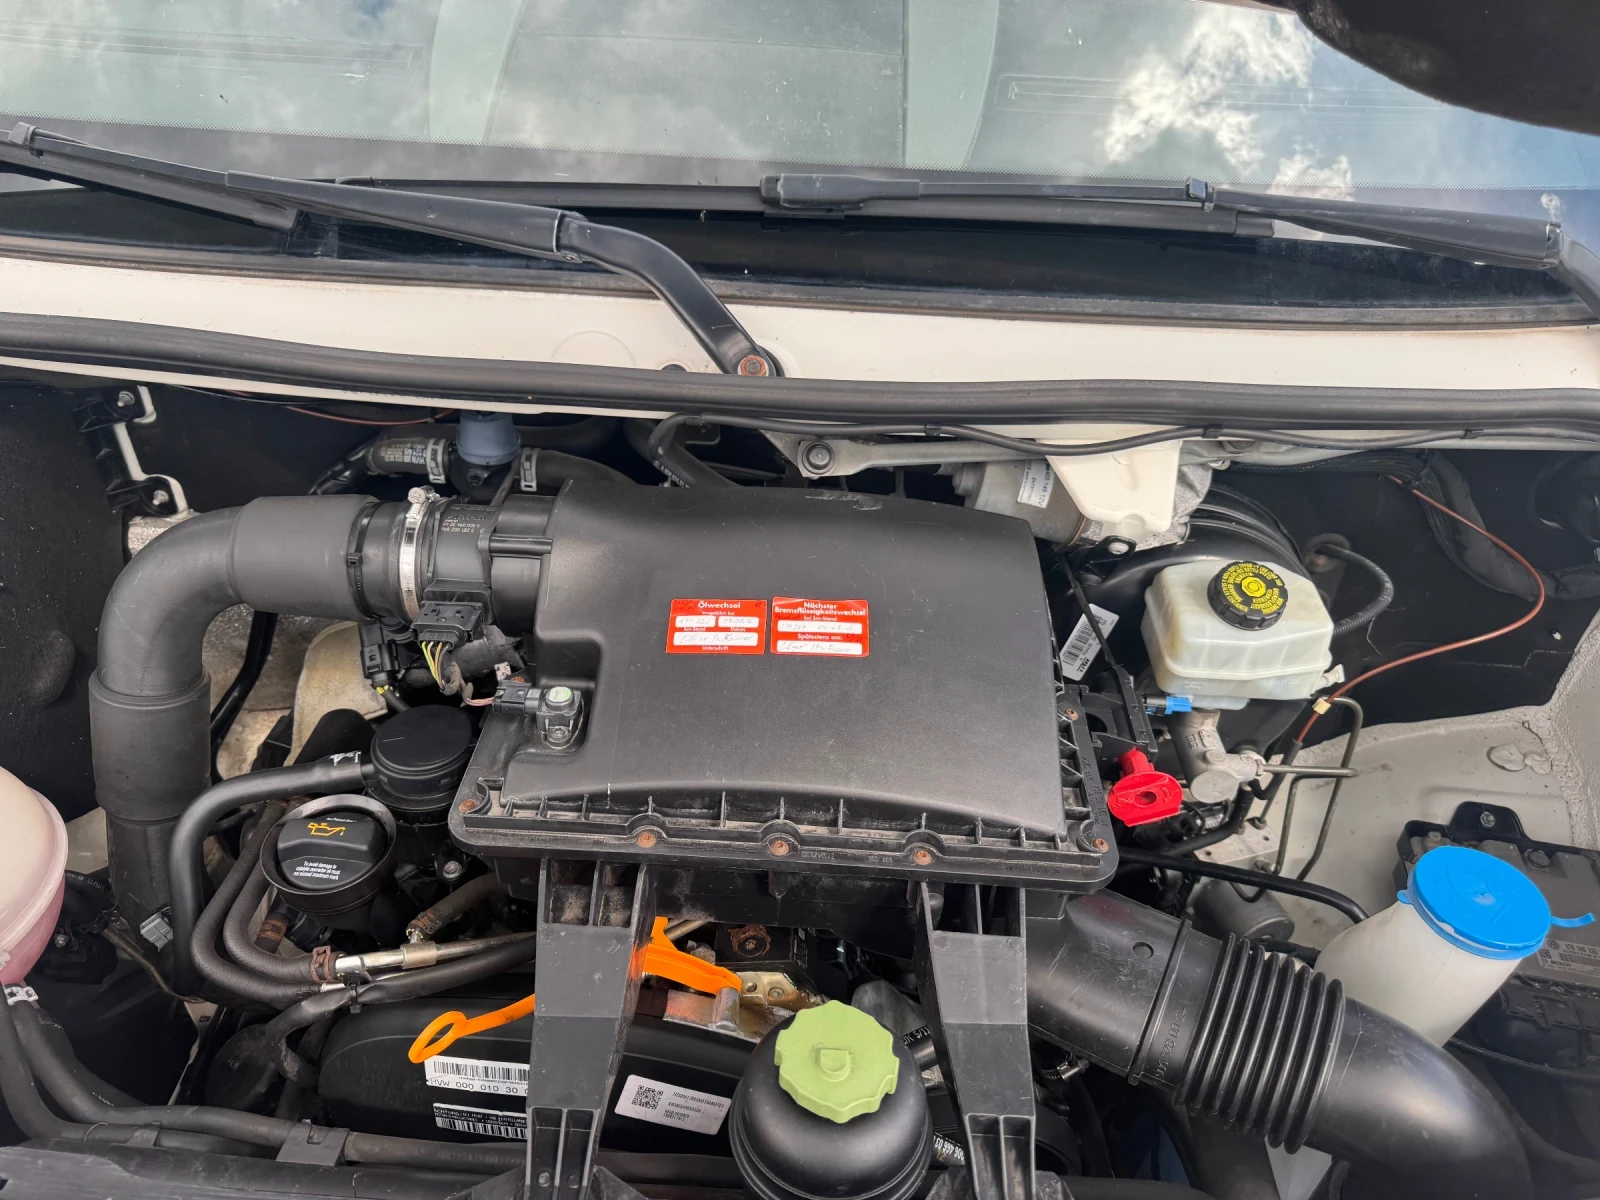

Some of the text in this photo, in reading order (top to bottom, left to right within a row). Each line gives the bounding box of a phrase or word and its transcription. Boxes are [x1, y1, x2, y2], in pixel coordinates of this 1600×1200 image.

[698, 600, 740, 609] Ölwechsel
[804, 602, 838, 610] Nächster
[774, 606, 866, 616] Bremsflüssigkeitswechsel
[430, 1079, 450, 1087] HVW
[480, 1084, 499, 1092] 010
